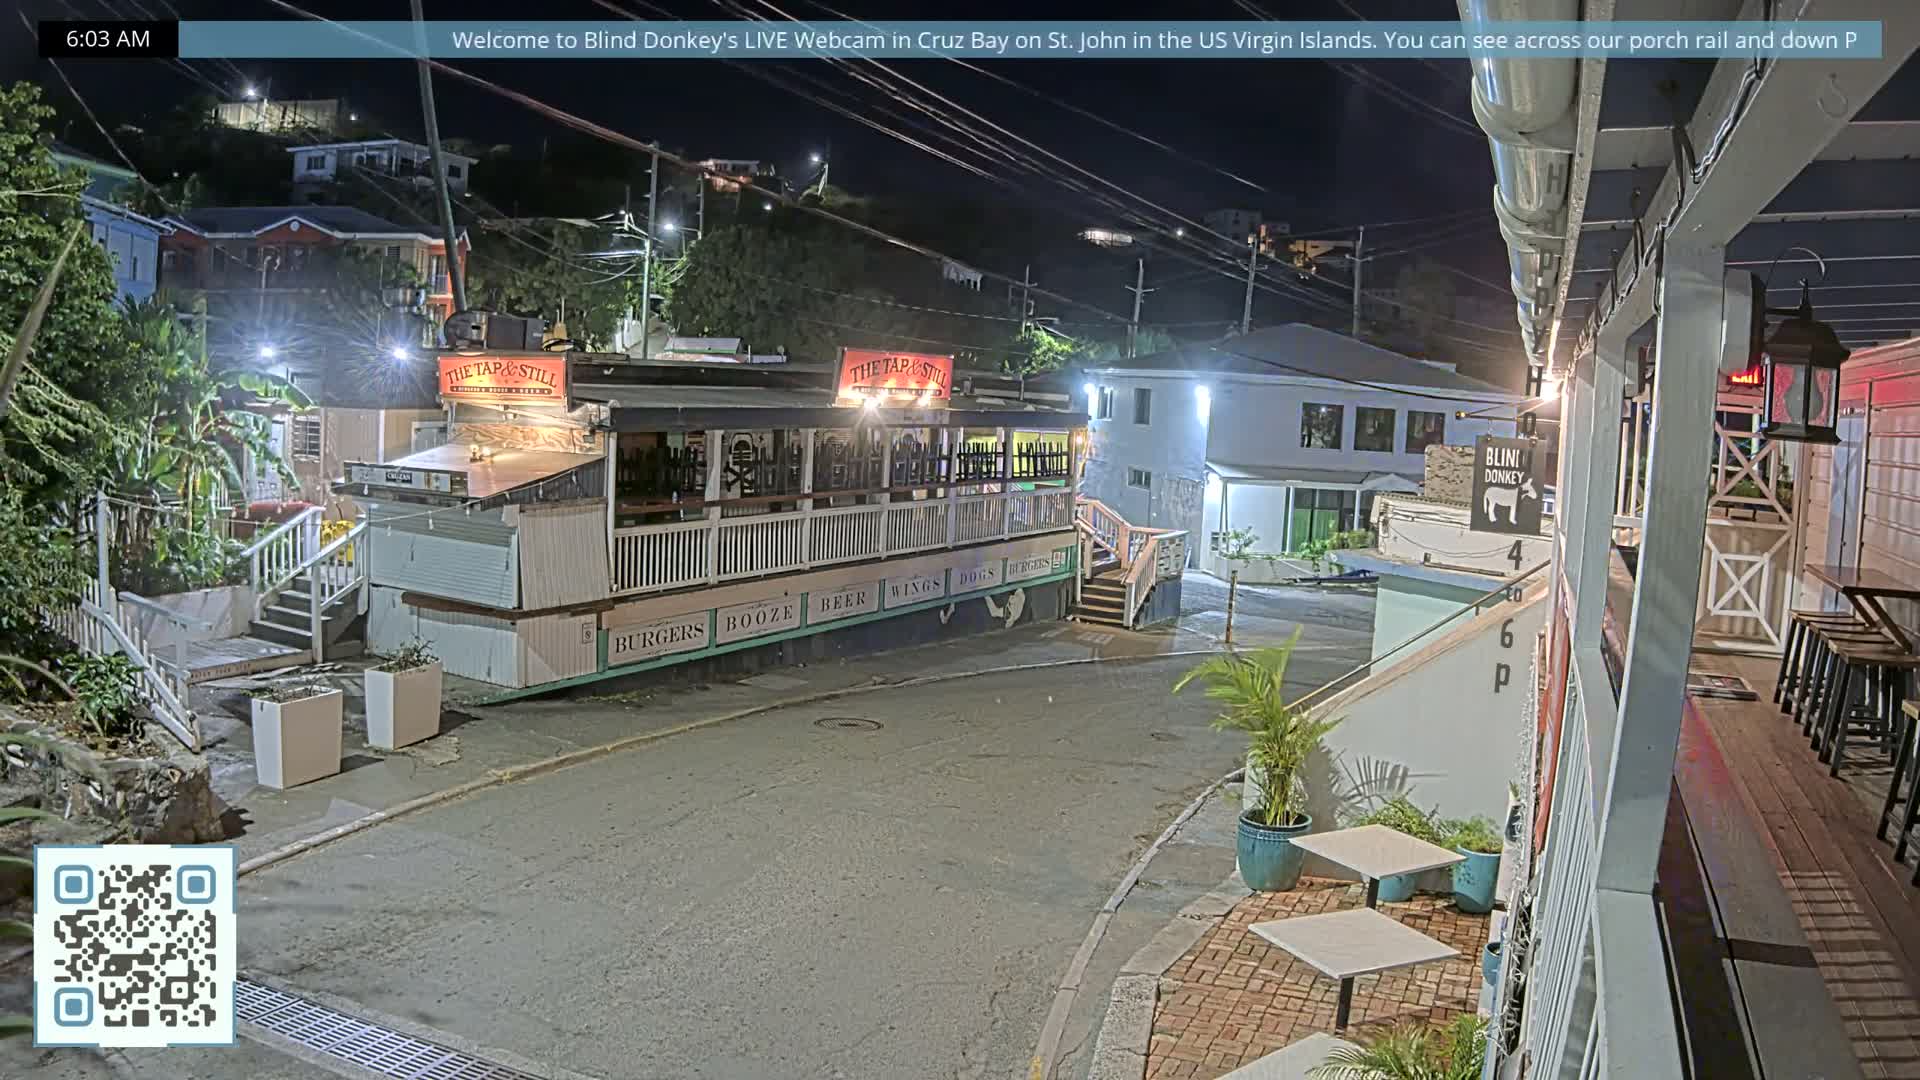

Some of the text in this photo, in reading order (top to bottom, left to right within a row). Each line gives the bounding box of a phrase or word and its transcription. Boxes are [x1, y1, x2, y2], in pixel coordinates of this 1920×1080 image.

[445, 360, 557, 388] THE TAP & STILL
[849, 357, 946, 389] THE TAP & STILL
[1484, 468, 1525, 485] DONKEY
[959, 567, 995, 586] DOGS
[1008, 556, 1050, 576] BURGERS
[890, 578, 941, 598] WINGS
[820, 591, 867, 613] BEER
[725, 604, 794, 633] BOOZE
[614, 622, 705, 654] BURGERS
